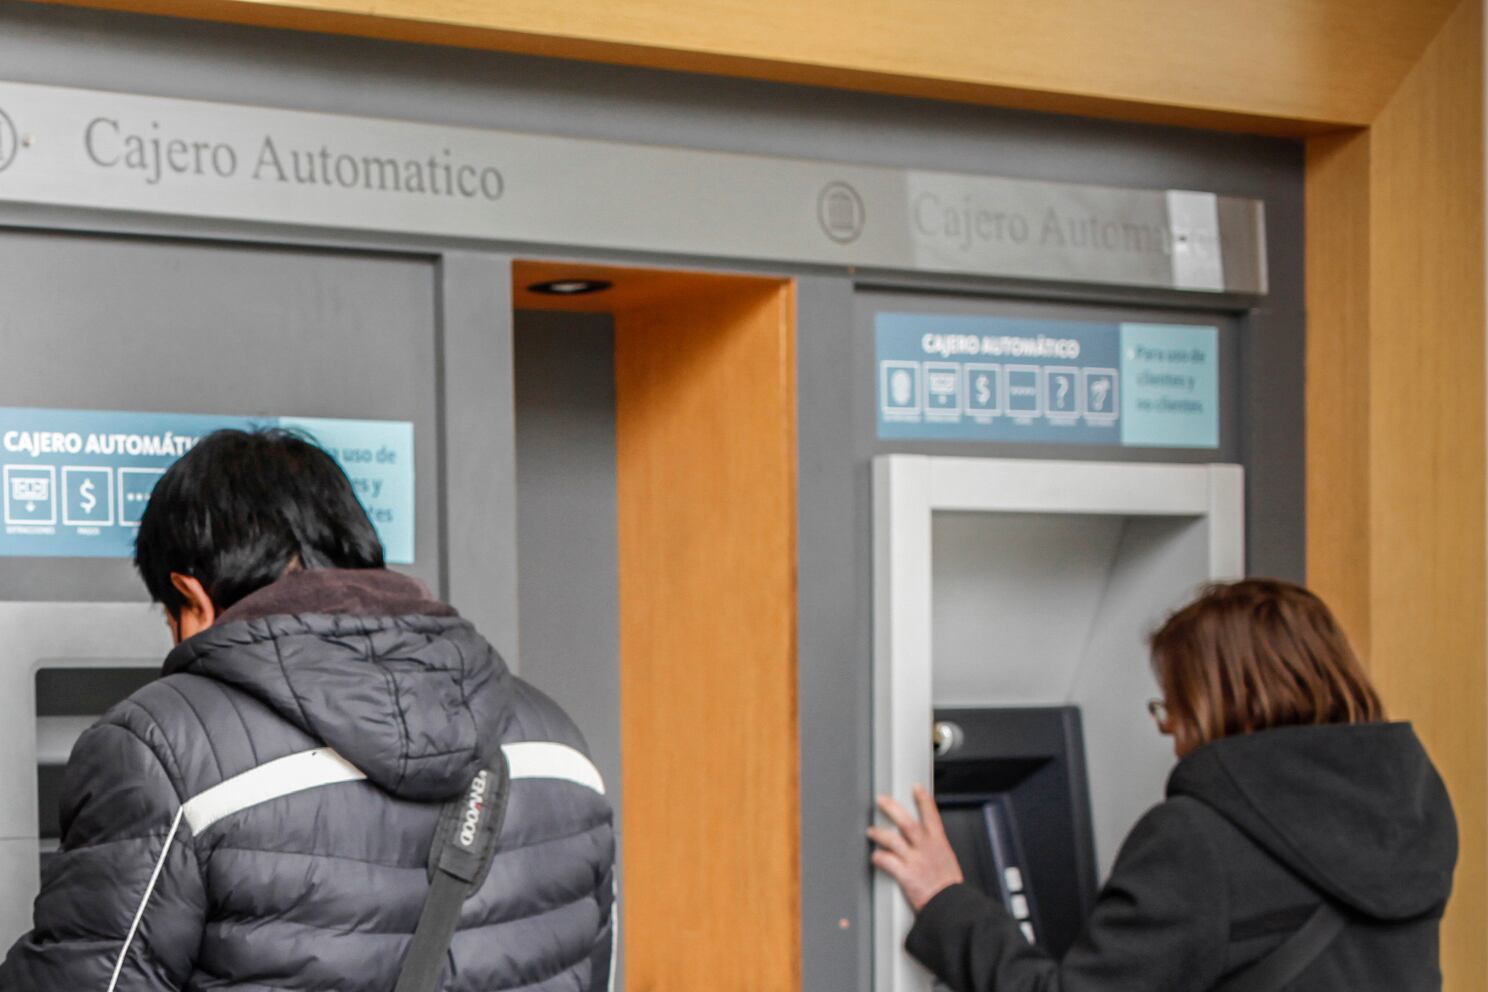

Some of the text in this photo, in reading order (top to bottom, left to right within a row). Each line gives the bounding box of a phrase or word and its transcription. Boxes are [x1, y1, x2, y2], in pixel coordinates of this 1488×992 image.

[84, 117, 505, 201] Cajero Automatico
[914, 191, 1031, 253] Cajero
[921, 333, 980, 358] CAJERO
[3, 430, 200, 457] CAJERO AUTOMÁTI
